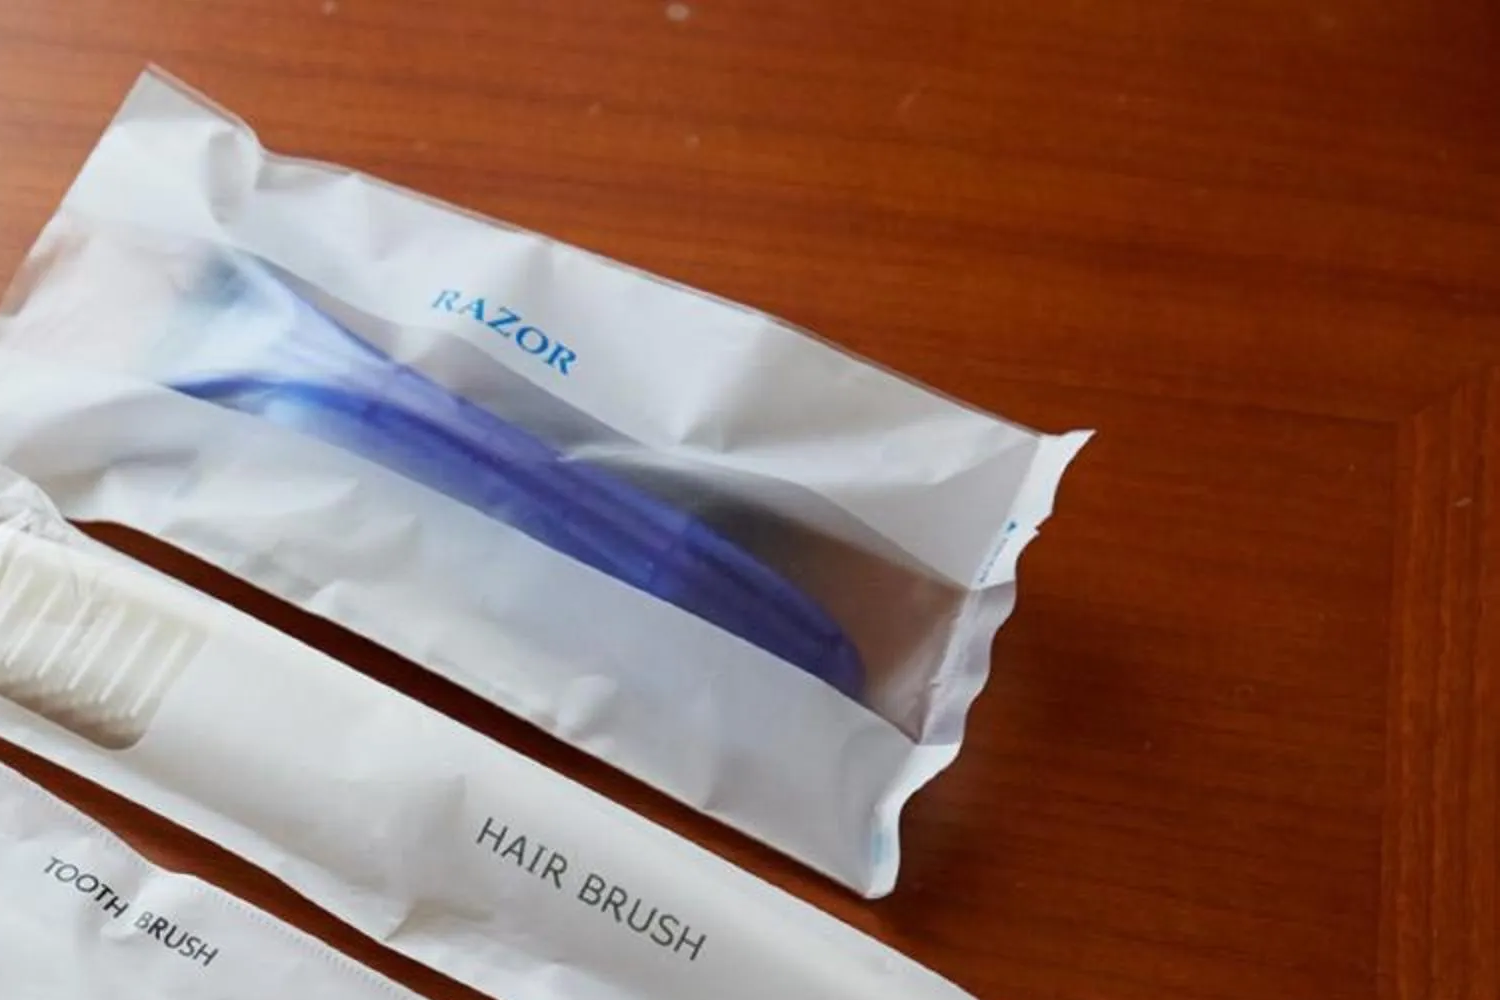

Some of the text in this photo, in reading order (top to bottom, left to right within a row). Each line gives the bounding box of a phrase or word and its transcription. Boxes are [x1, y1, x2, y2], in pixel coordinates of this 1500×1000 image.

[431, 289, 577, 376] RAZOR
[43, 855, 220, 967] TOOTH BRUSH
[476, 816, 707, 961] HAIR BRUSH
